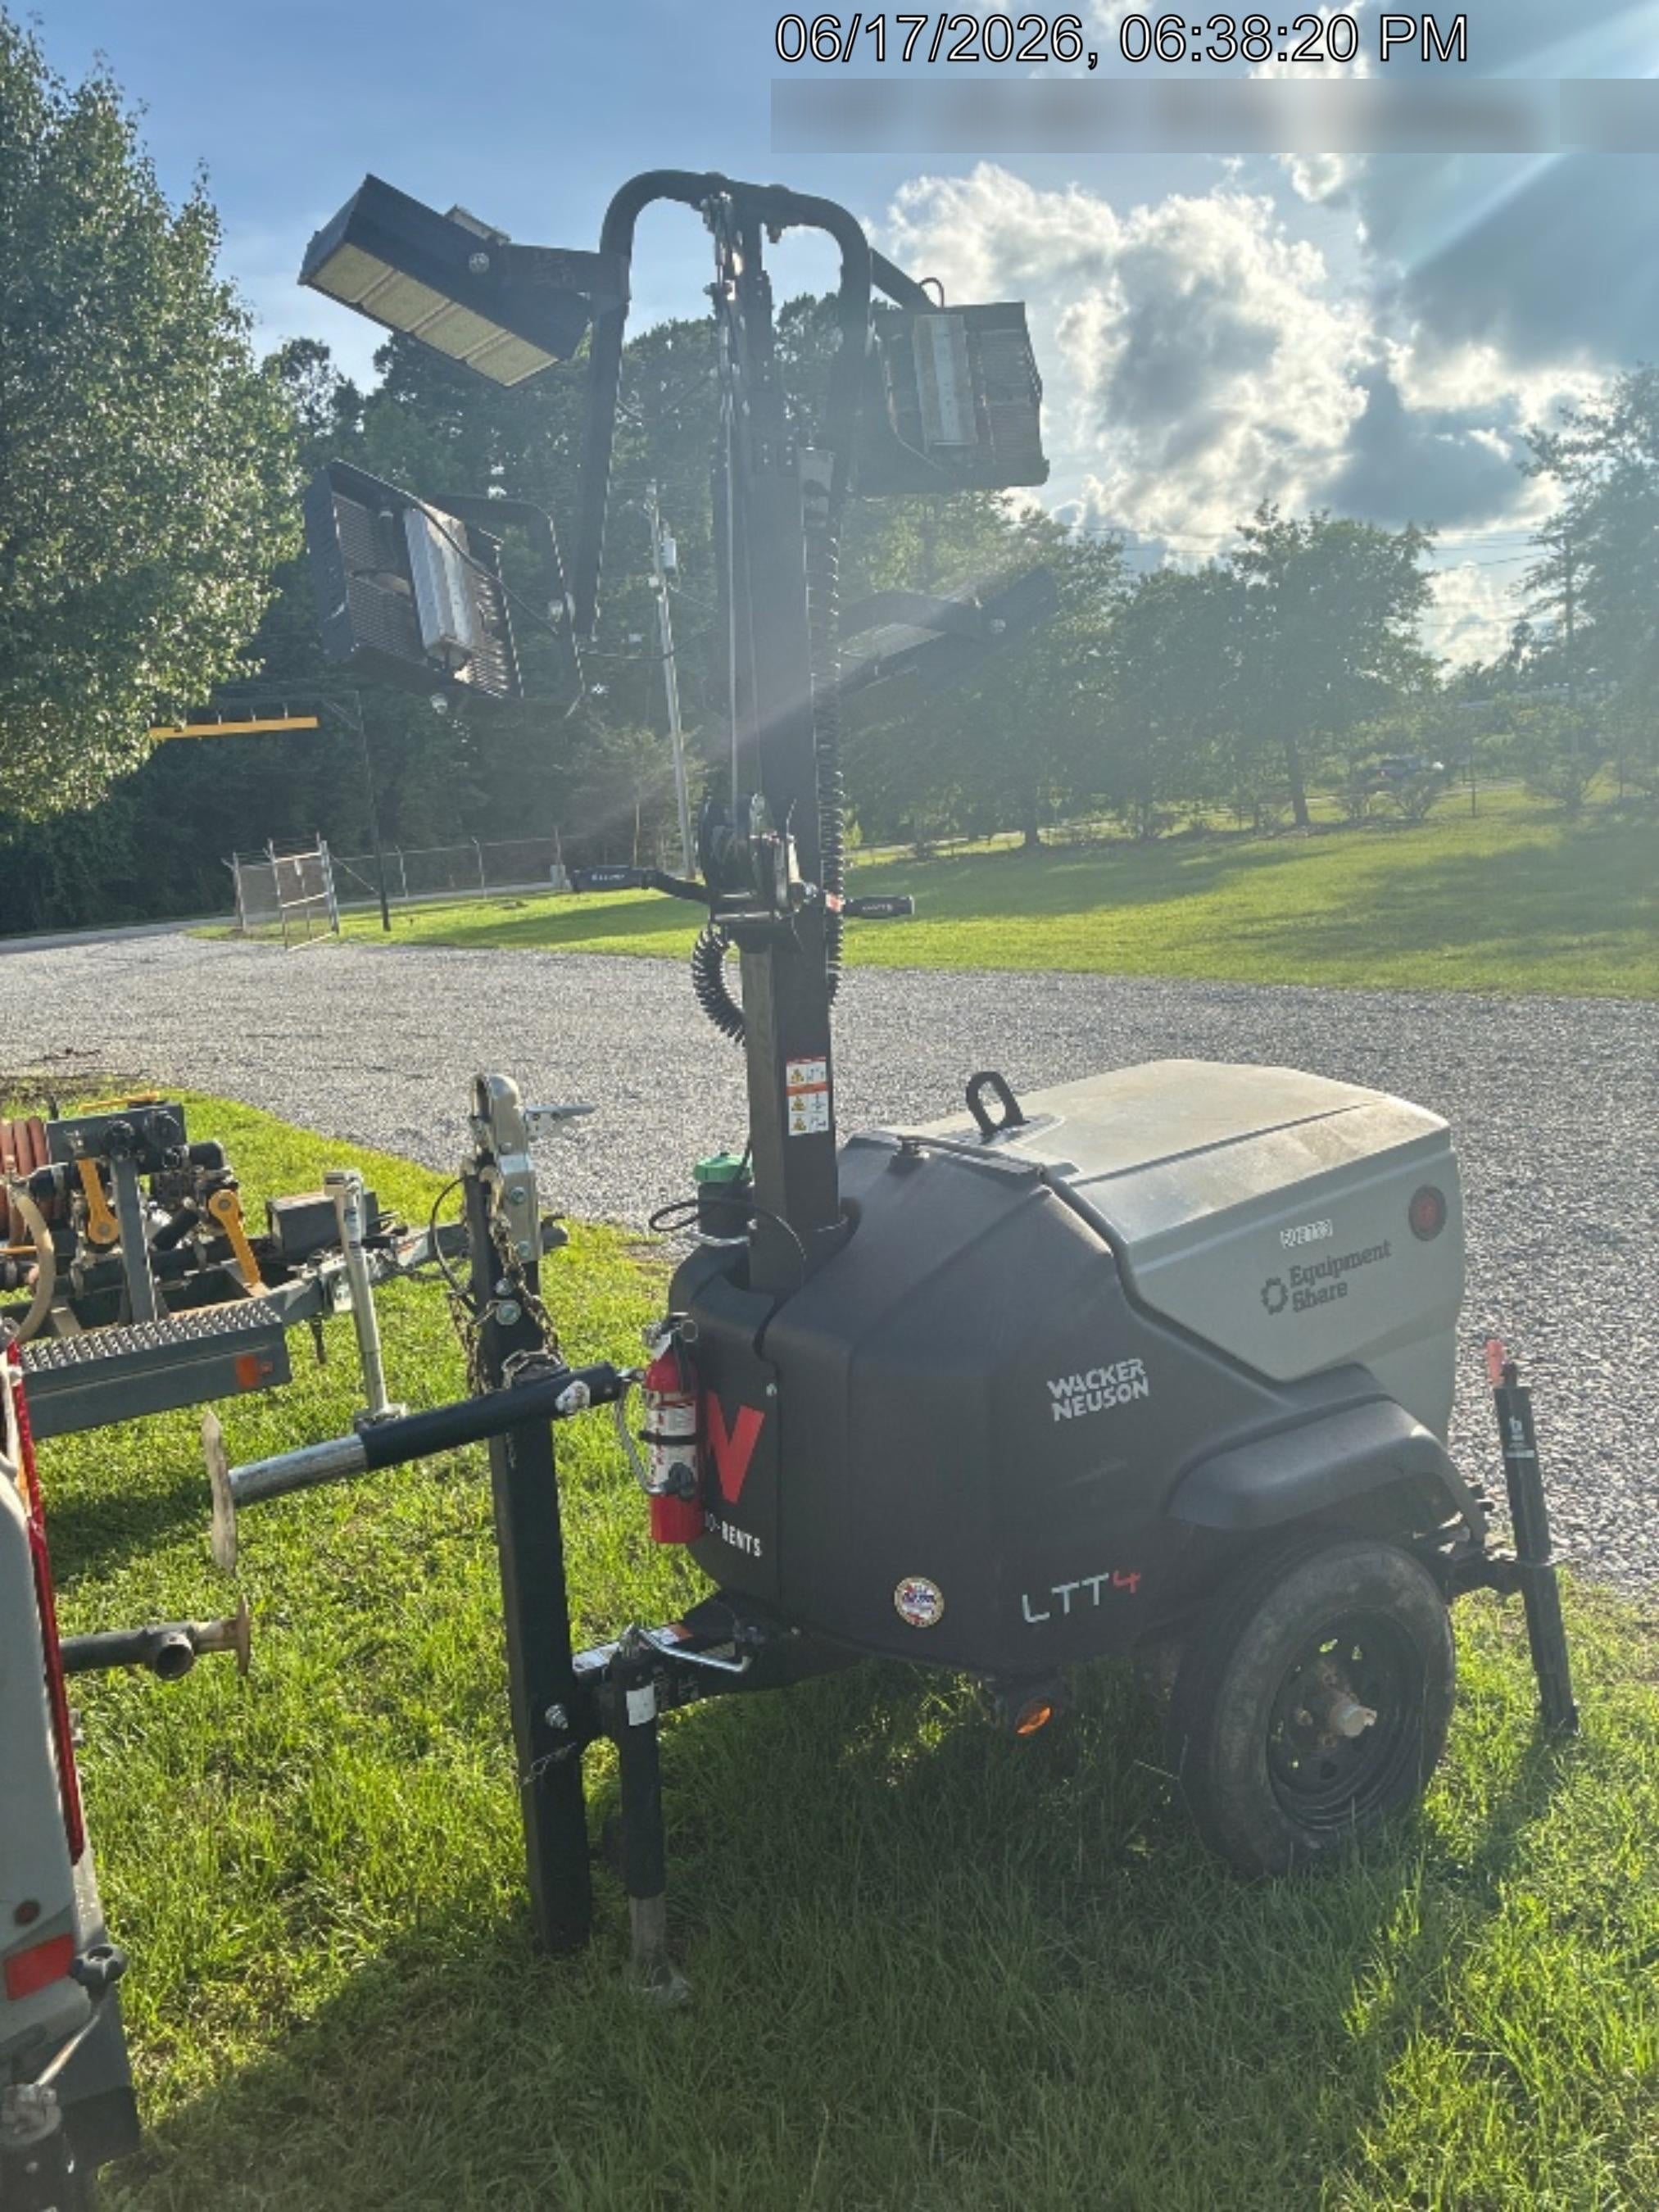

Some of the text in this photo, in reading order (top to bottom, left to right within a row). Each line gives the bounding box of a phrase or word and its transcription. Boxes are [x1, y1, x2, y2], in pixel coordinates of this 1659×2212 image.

[1290, 1238, 1392, 1288] Equipment
[1293, 1282, 1349, 1312] Share
[1046, 1358, 1147, 1399] WACKER
[1051, 1376, 1149, 1422] NEUSON
